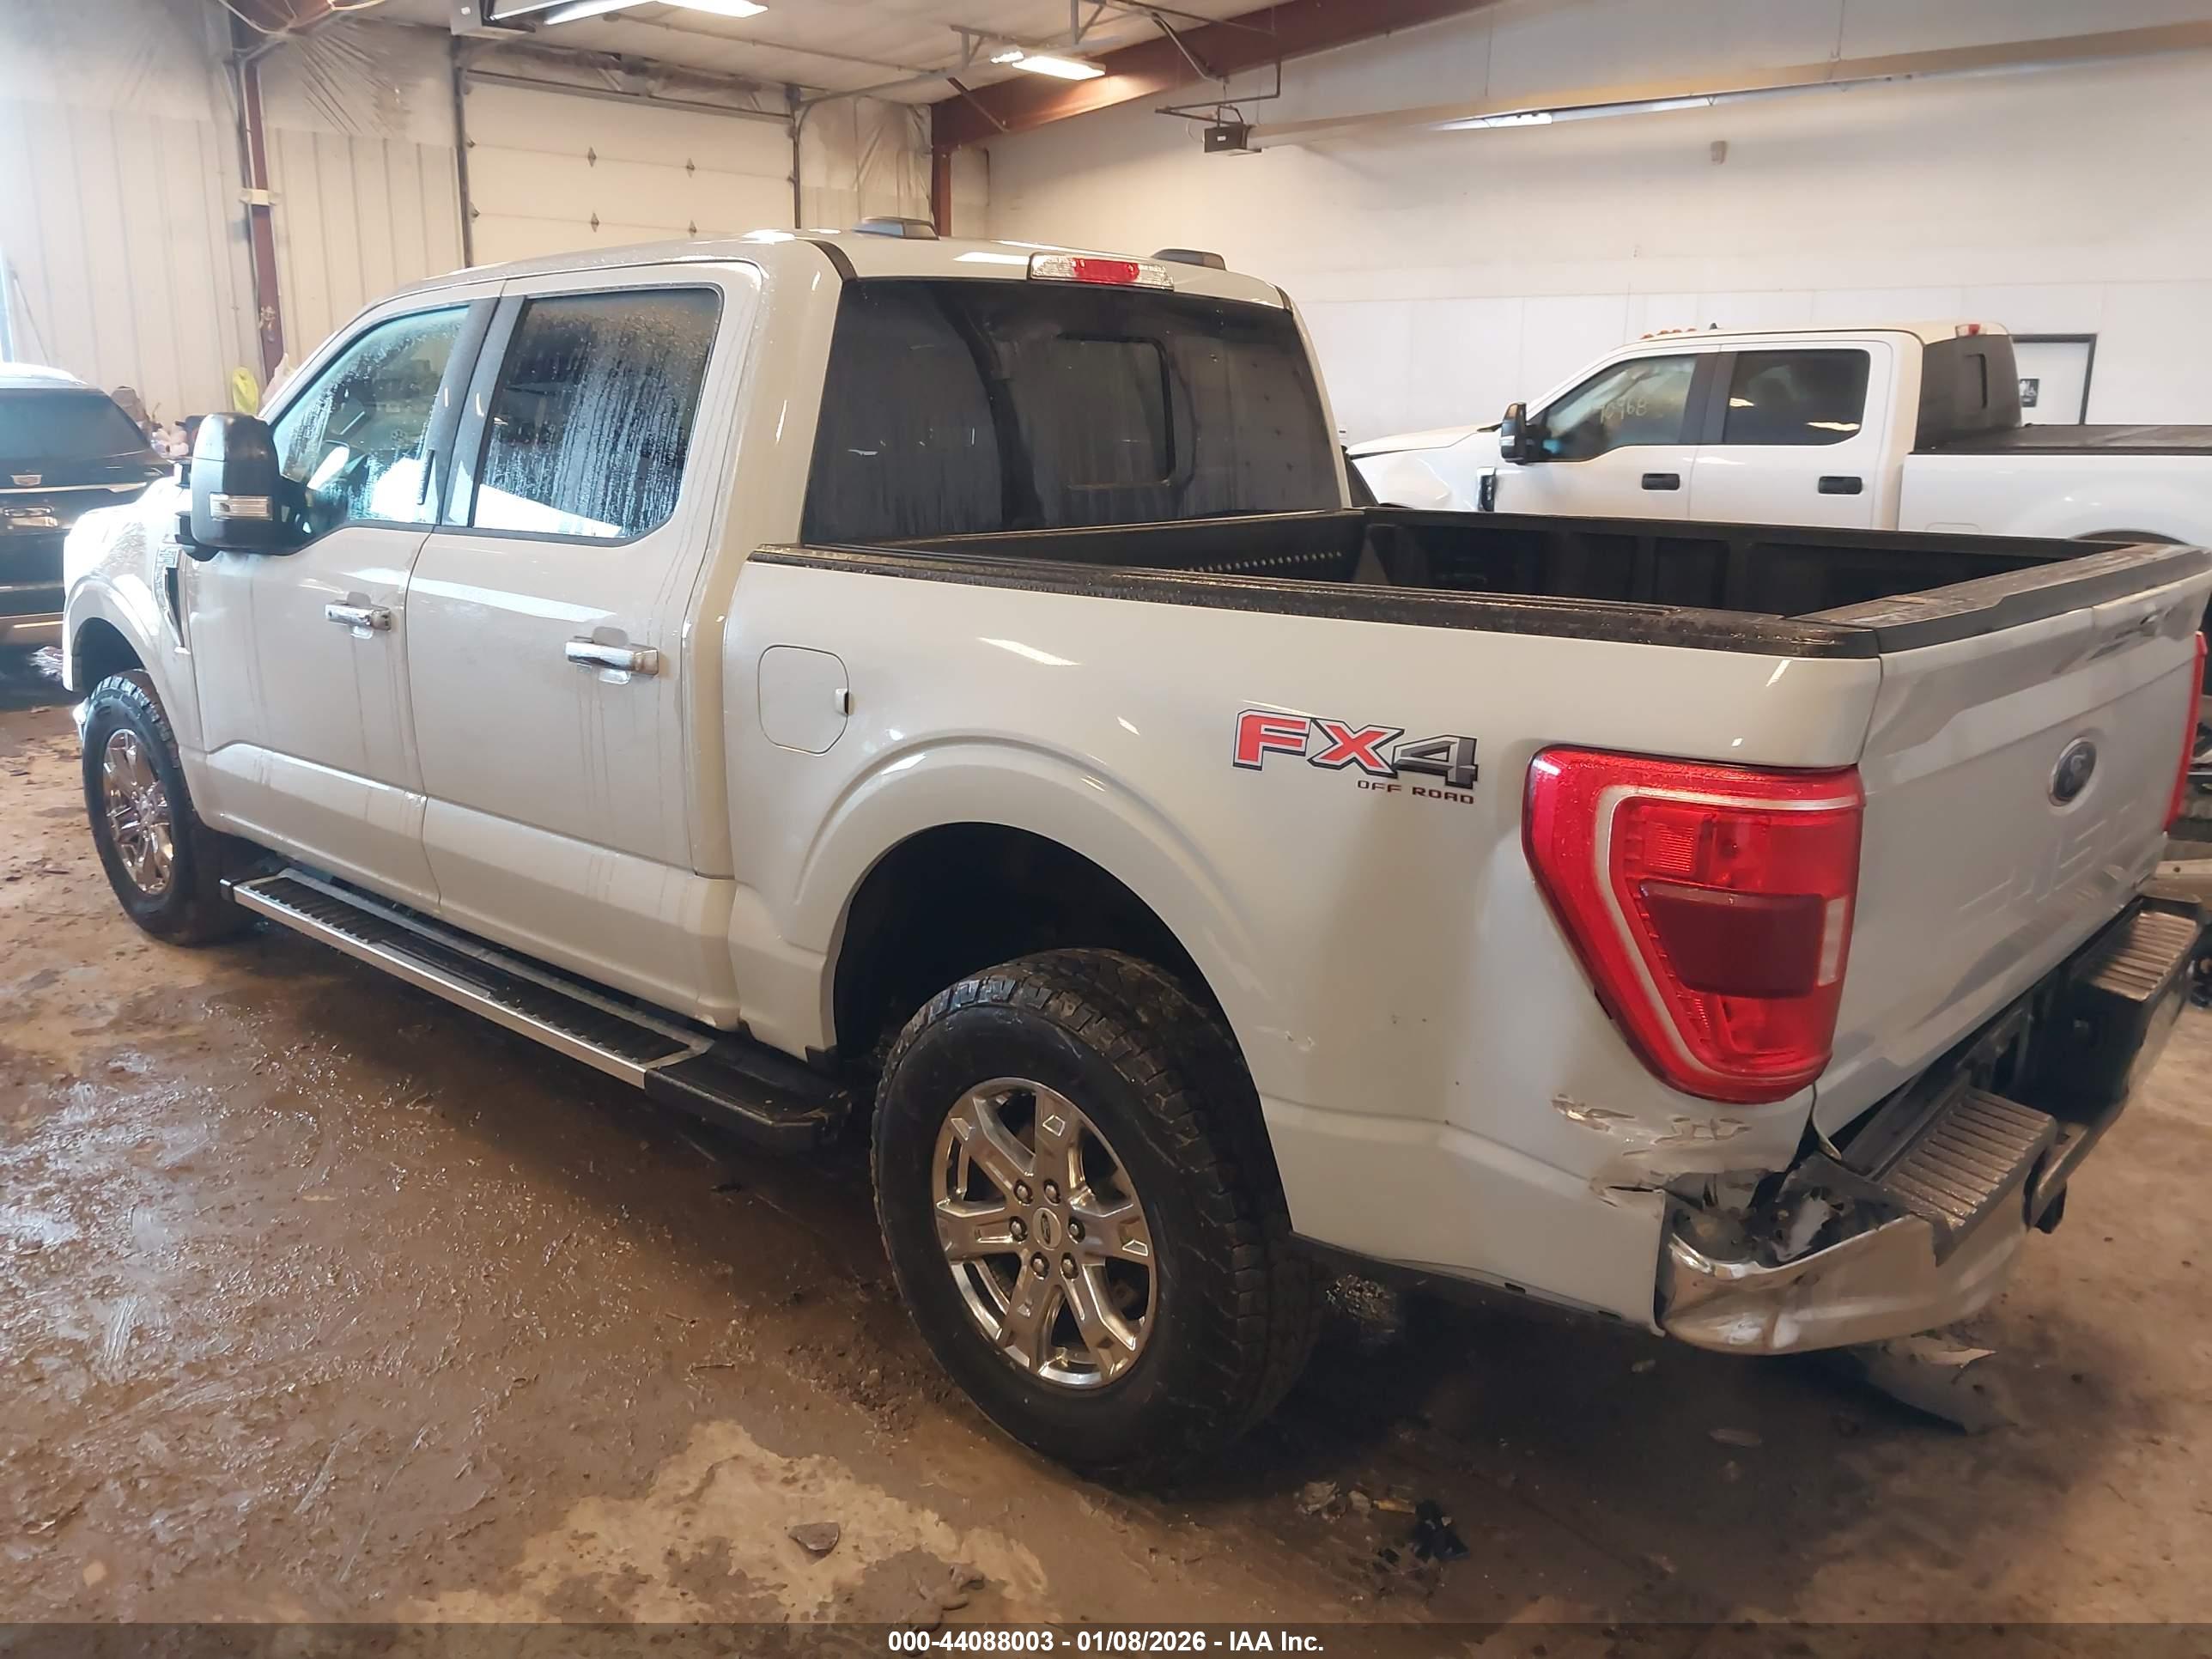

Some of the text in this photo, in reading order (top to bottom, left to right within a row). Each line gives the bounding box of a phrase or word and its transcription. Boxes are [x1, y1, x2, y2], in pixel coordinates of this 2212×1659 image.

[1233, 708, 1478, 790] FX4
[1358, 780, 1475, 805] OFF ROAD
